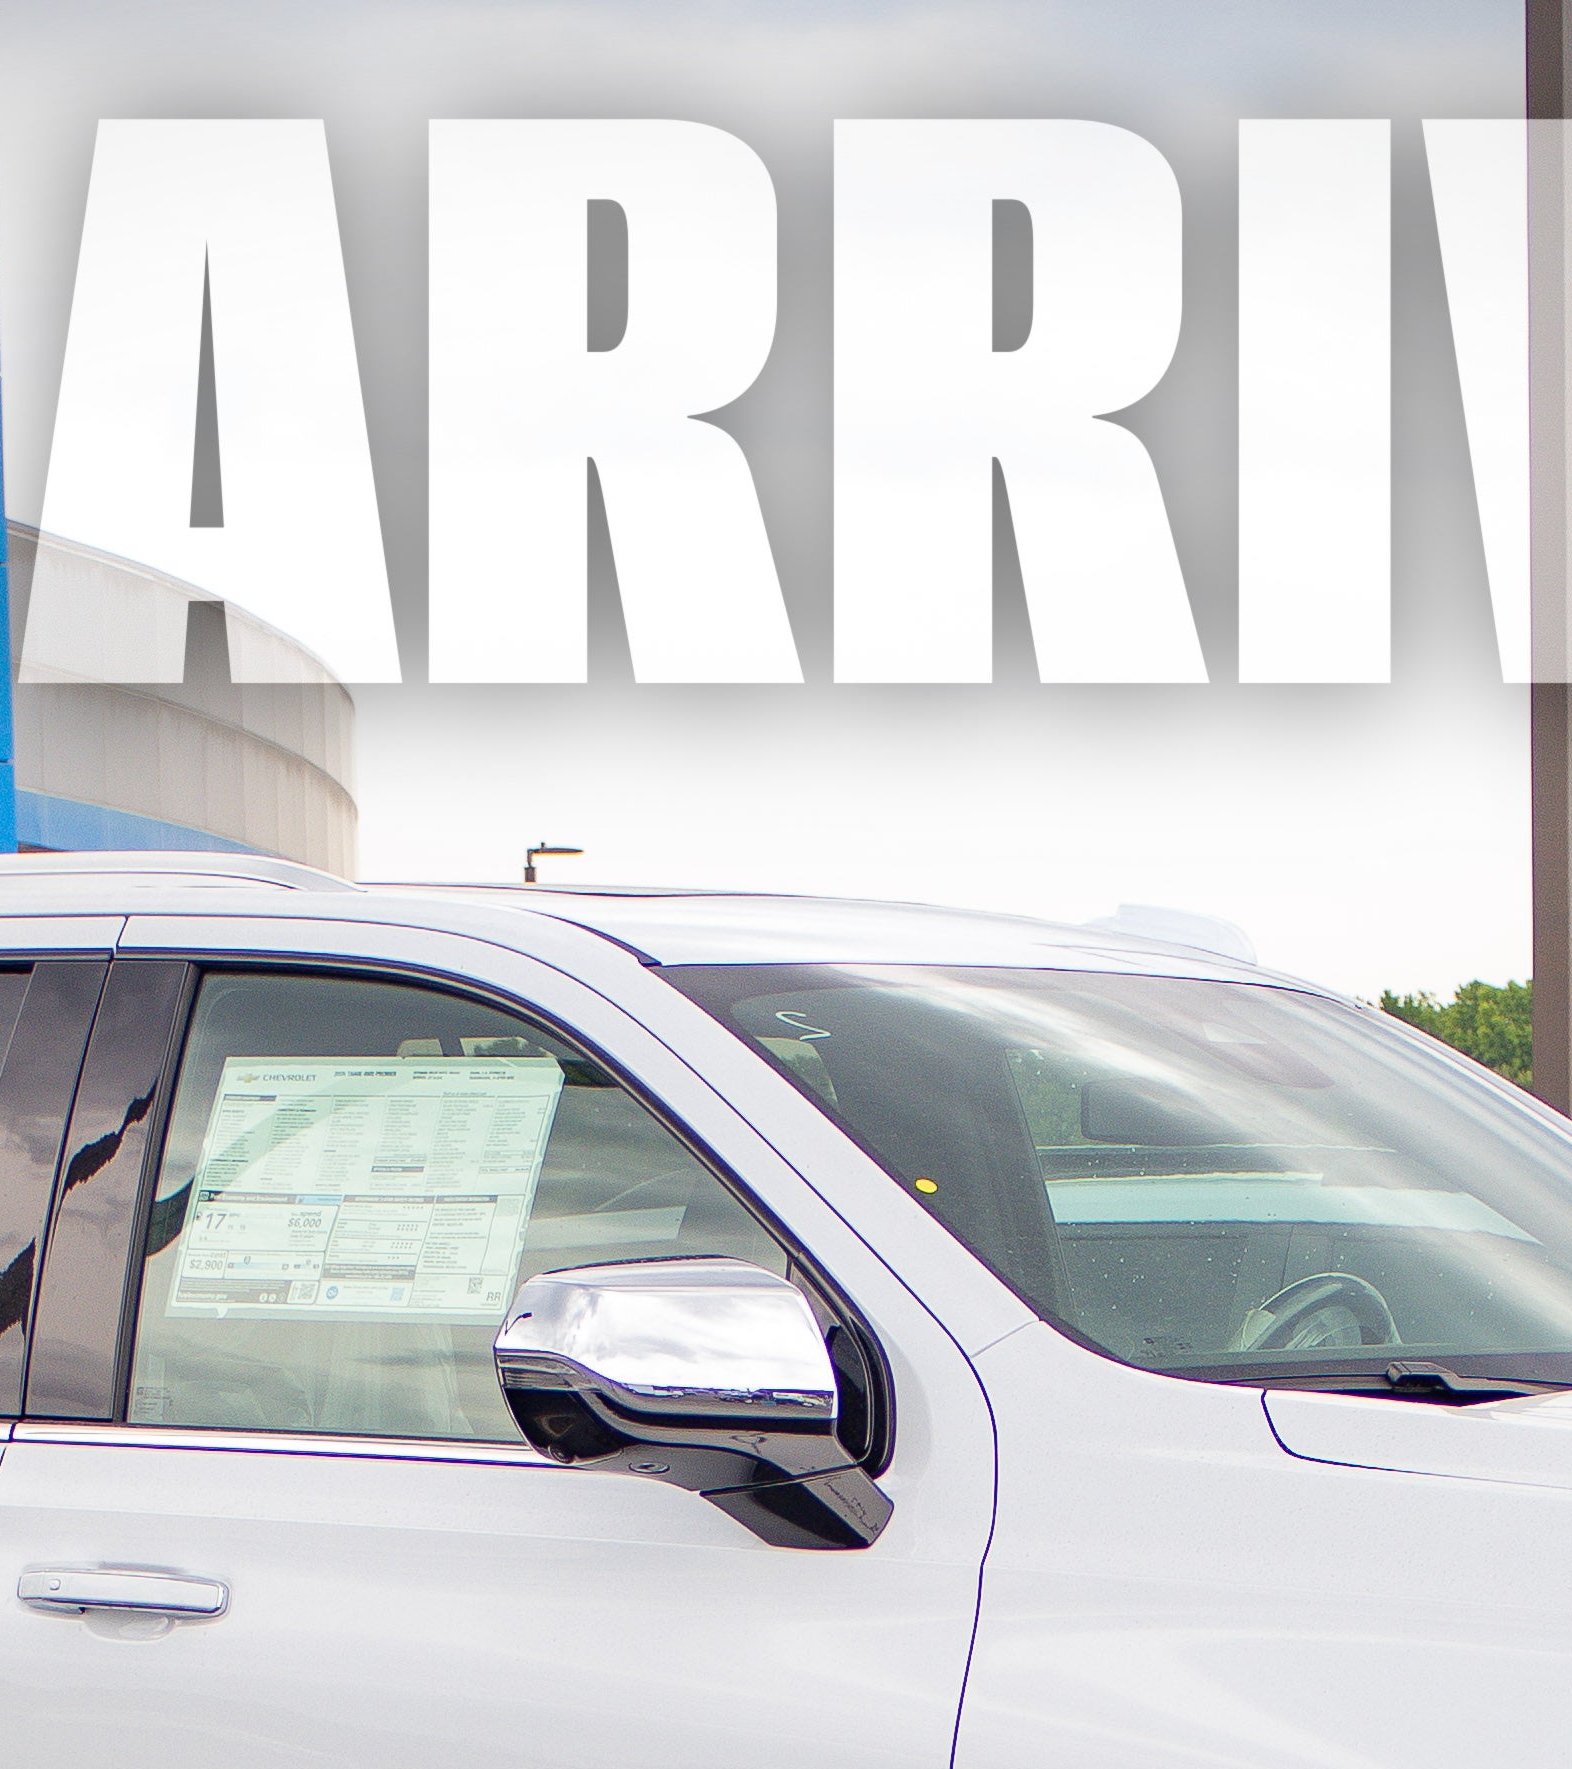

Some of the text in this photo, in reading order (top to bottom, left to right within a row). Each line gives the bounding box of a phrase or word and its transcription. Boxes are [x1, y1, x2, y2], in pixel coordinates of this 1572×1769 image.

[262, 1073, 317, 1082] CHEVROLET
[206, 1213, 227, 1229] 17
[287, 1218, 322, 1228] $6,000
